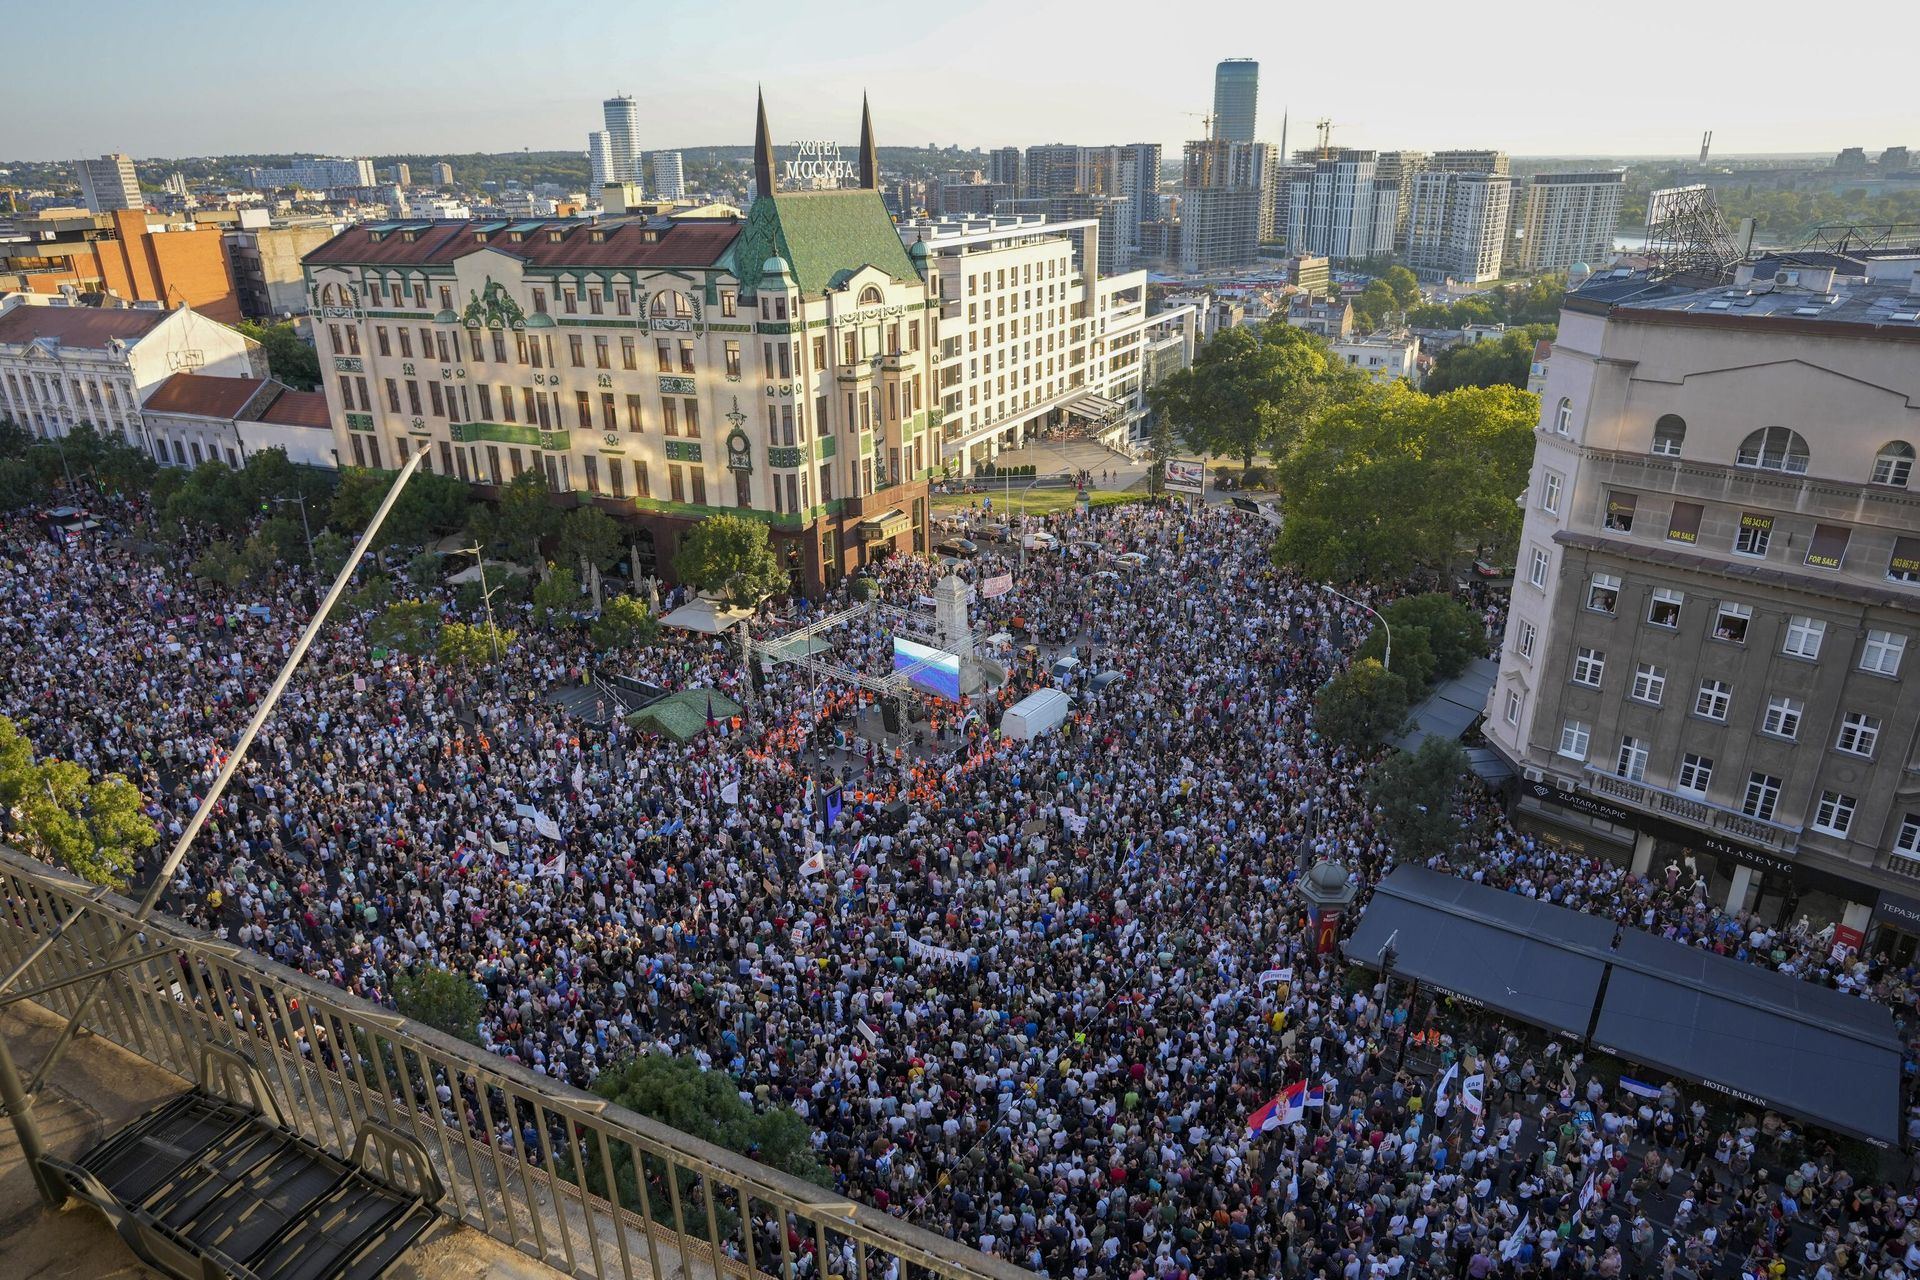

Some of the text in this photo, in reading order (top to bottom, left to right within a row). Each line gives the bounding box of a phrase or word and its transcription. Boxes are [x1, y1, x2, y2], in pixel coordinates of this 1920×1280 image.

[798, 140, 841, 156] ХОТЕЛ
[785, 160, 855, 179] МОСКВА
[1669, 530, 1696, 542] FOR SALE
[1808, 555, 1838, 567] FOR SALE
[1558, 792, 1627, 820] ZLATARA PAPIĆ
[1705, 840, 1793, 873] BALAŠEVIĆ
[1456, 993, 1485, 1007] BALKAN
[1703, 1079, 1767, 1107] HOTEL BALKAN
